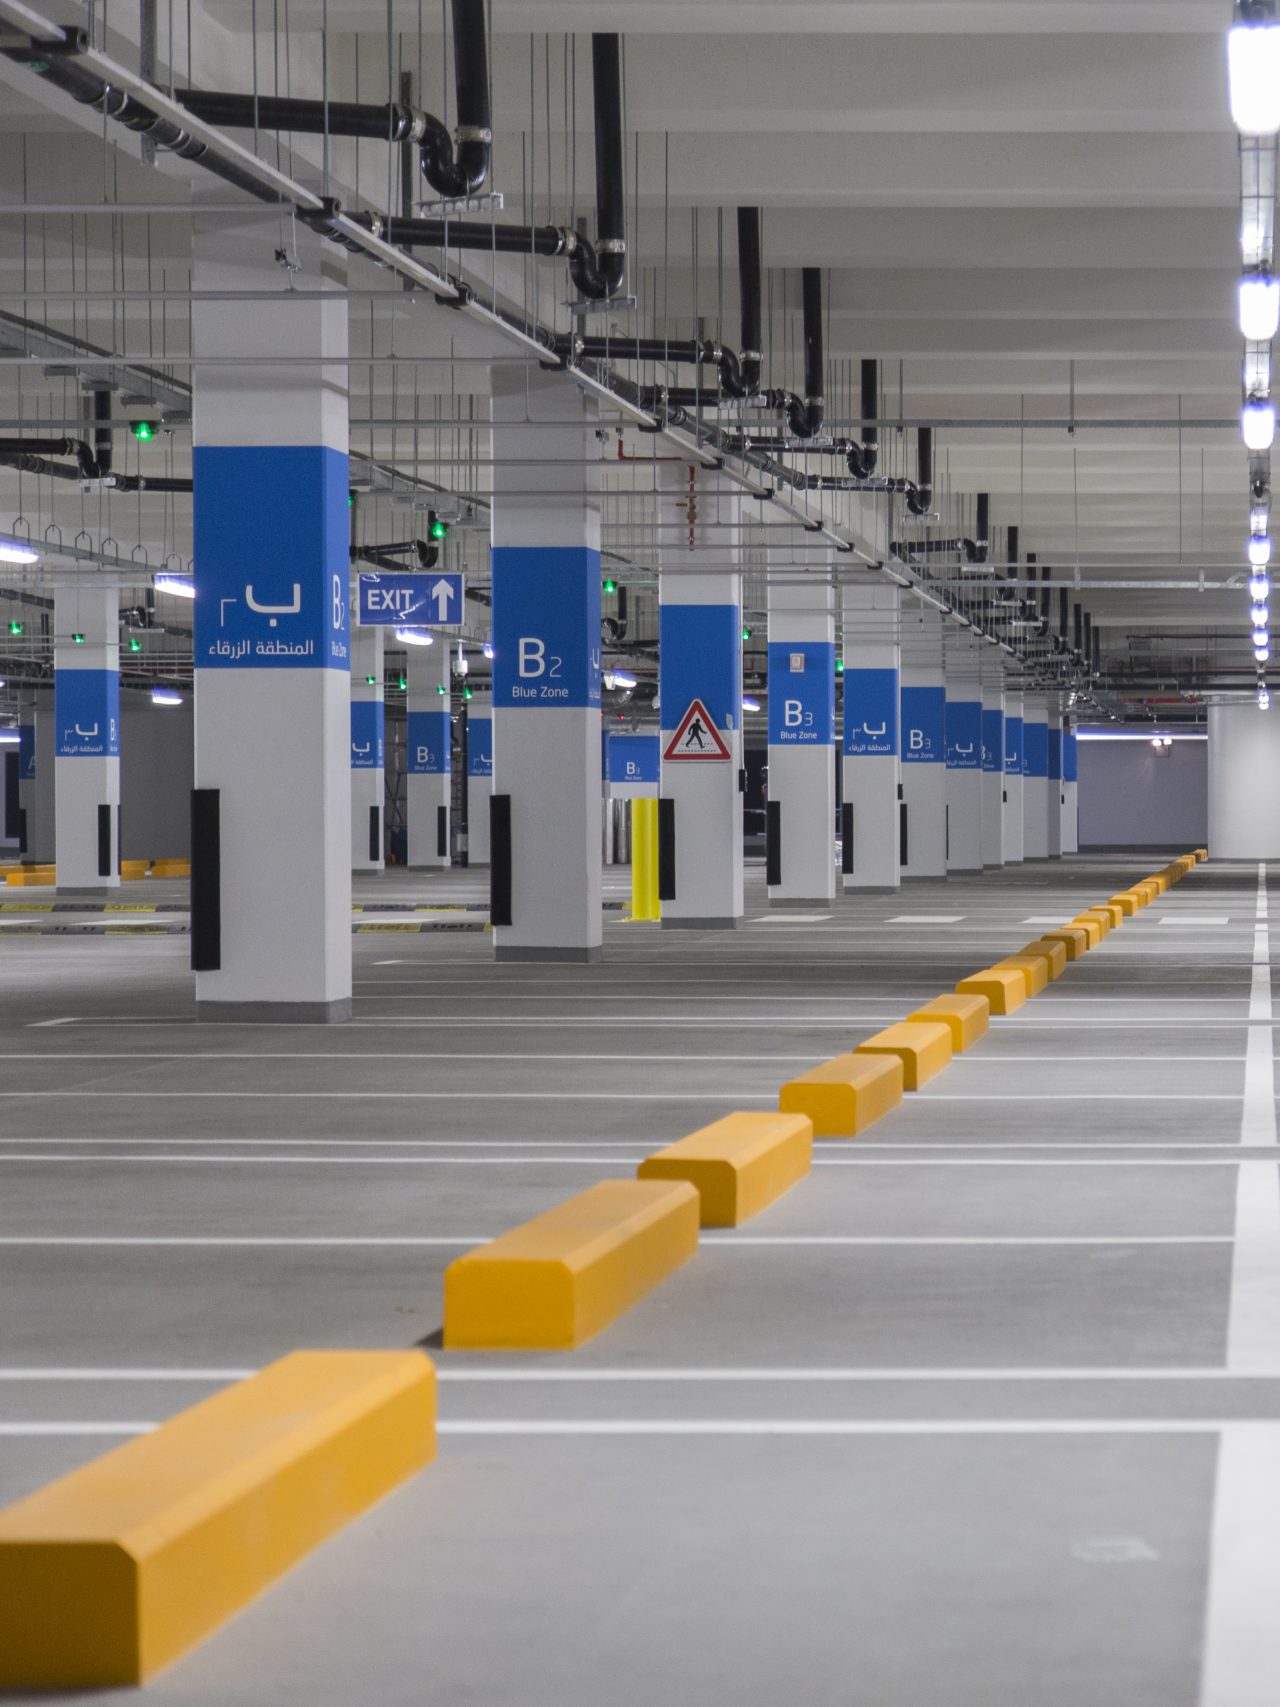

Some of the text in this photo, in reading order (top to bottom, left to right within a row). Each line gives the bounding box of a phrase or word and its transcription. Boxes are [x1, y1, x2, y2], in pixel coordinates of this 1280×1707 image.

[367, 589, 414, 610] EXIT
[208, 639, 314, 660] المنطقة الزرقاء
[512, 686, 569, 698] Blue Zone
[780, 731, 818, 739] Blue Zone
